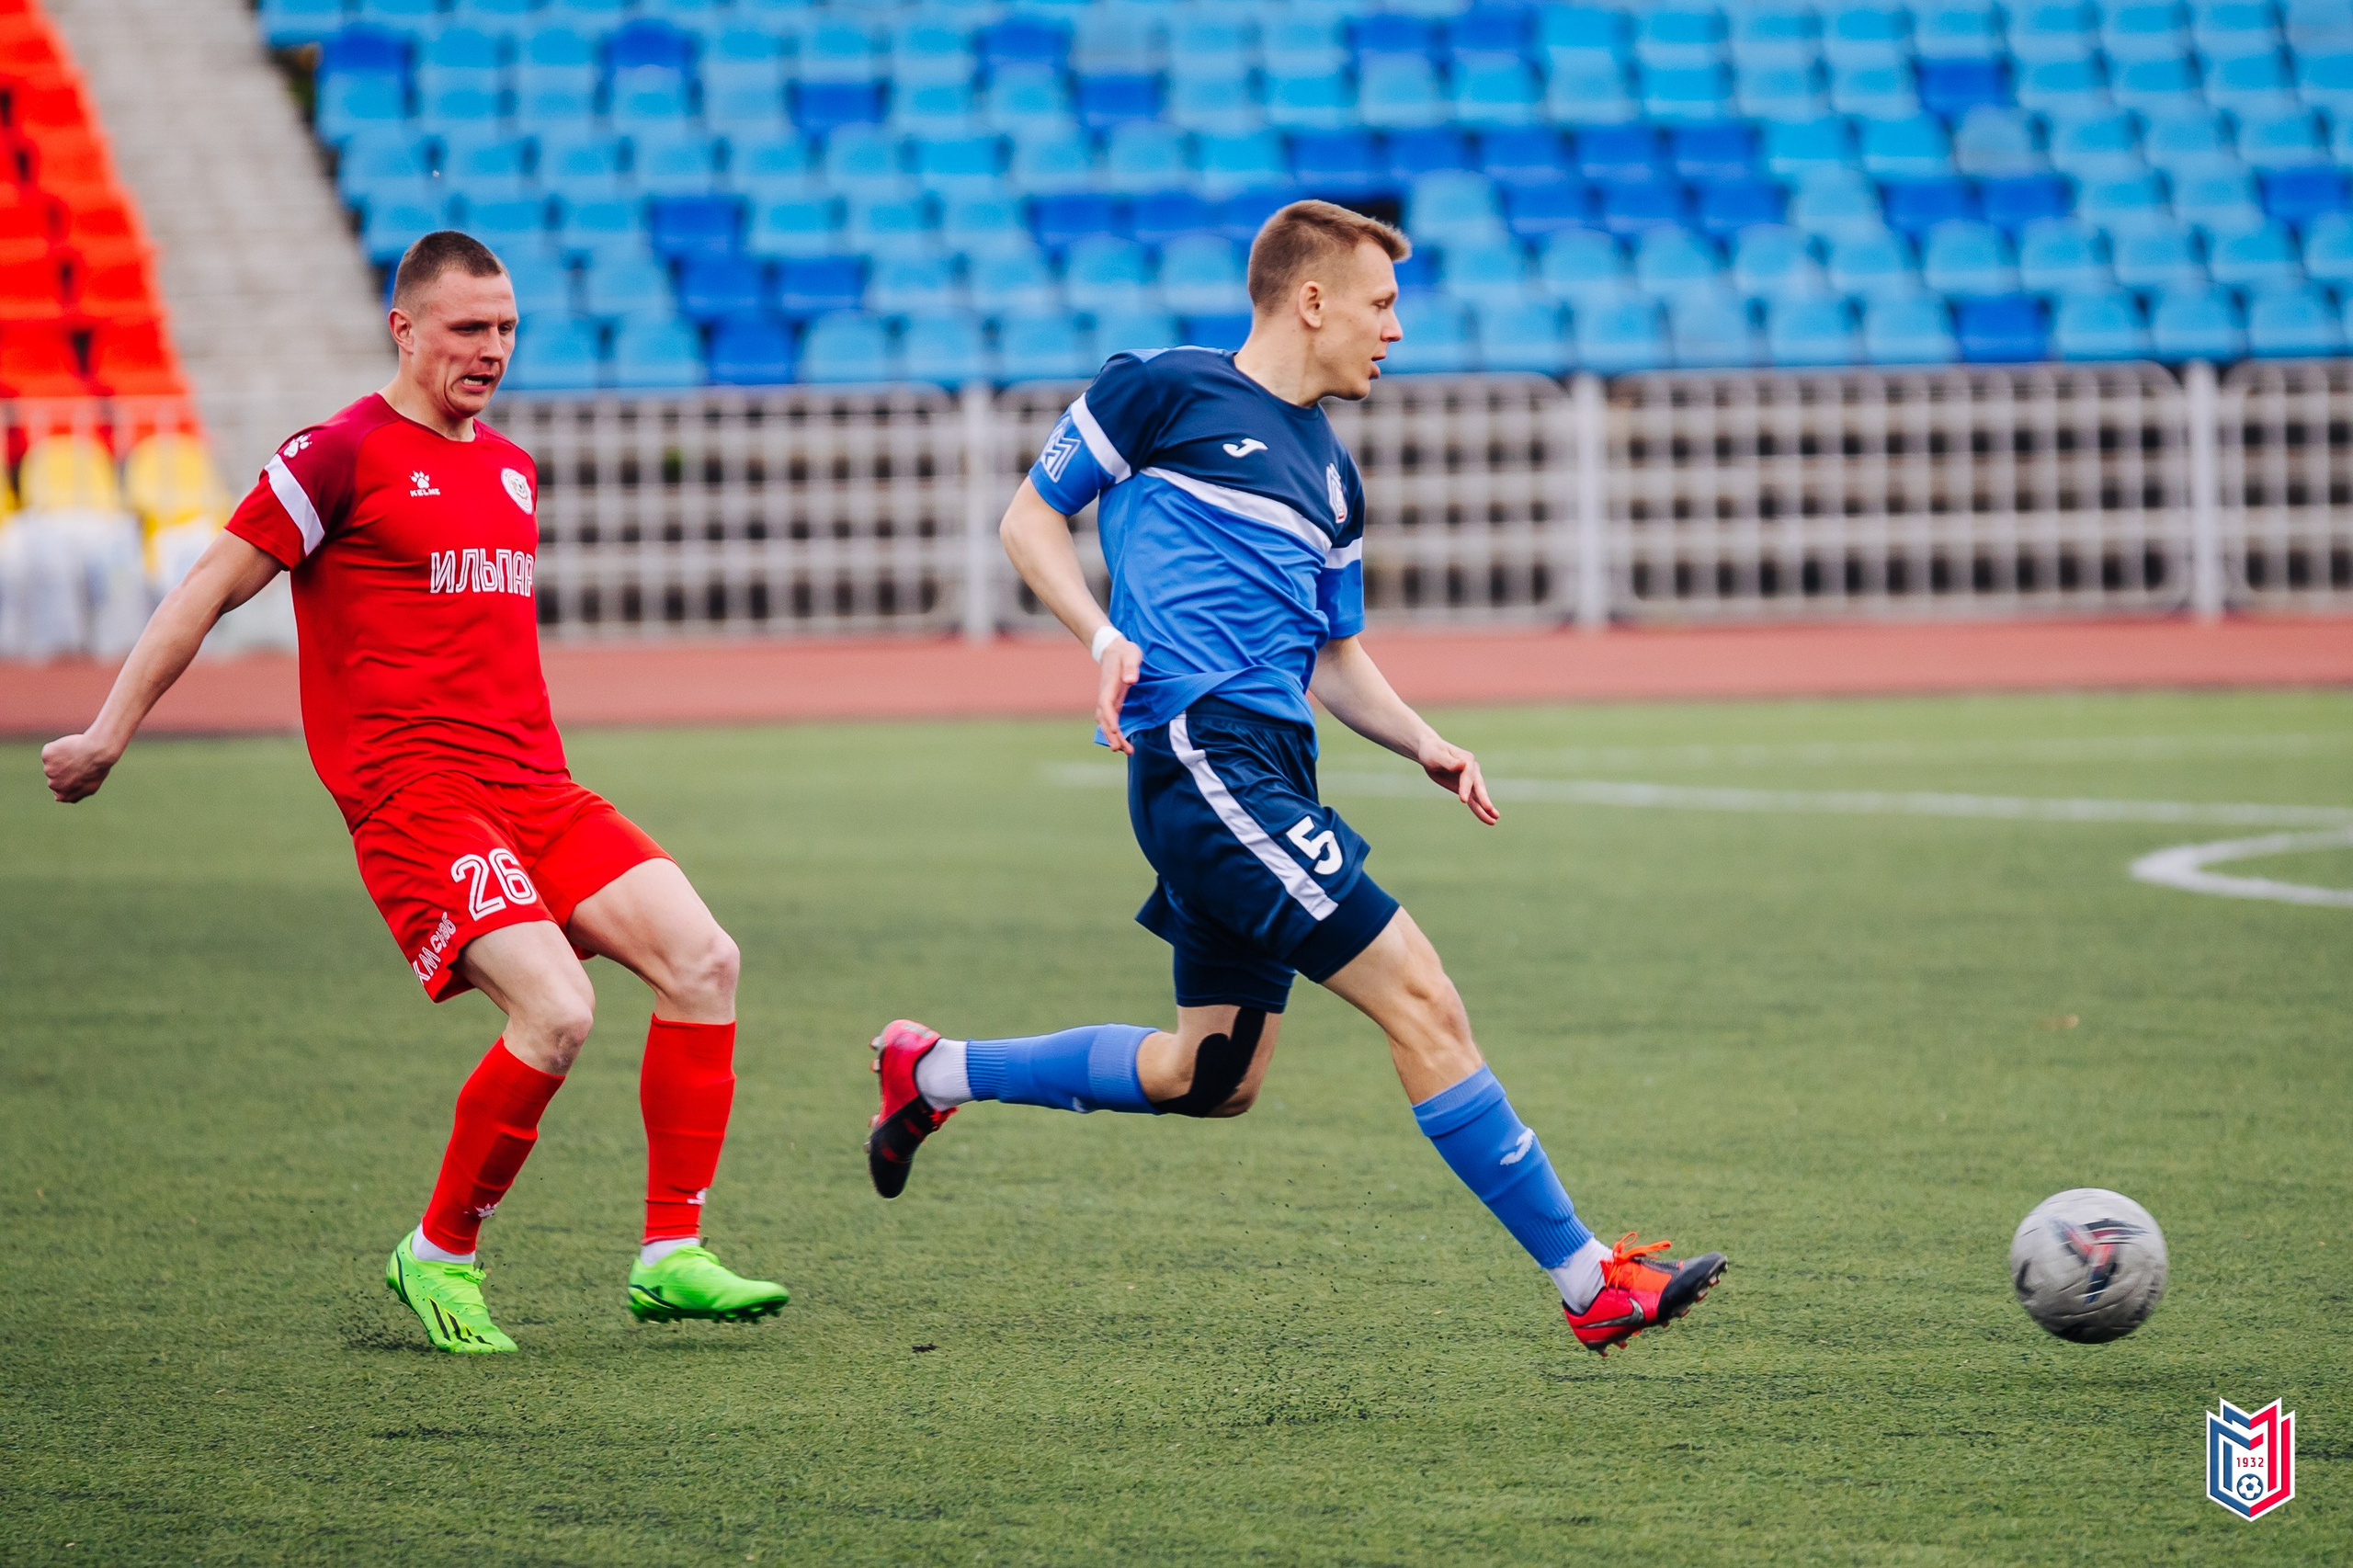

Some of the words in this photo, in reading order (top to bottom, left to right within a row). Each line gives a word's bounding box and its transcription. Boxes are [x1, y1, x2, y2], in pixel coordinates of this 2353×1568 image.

[410, 488, 441, 497] KELME
[429, 548, 535, 597] ИЛЬПАР
[1286, 815, 1343, 875] 5
[450, 847, 537, 922] 26
